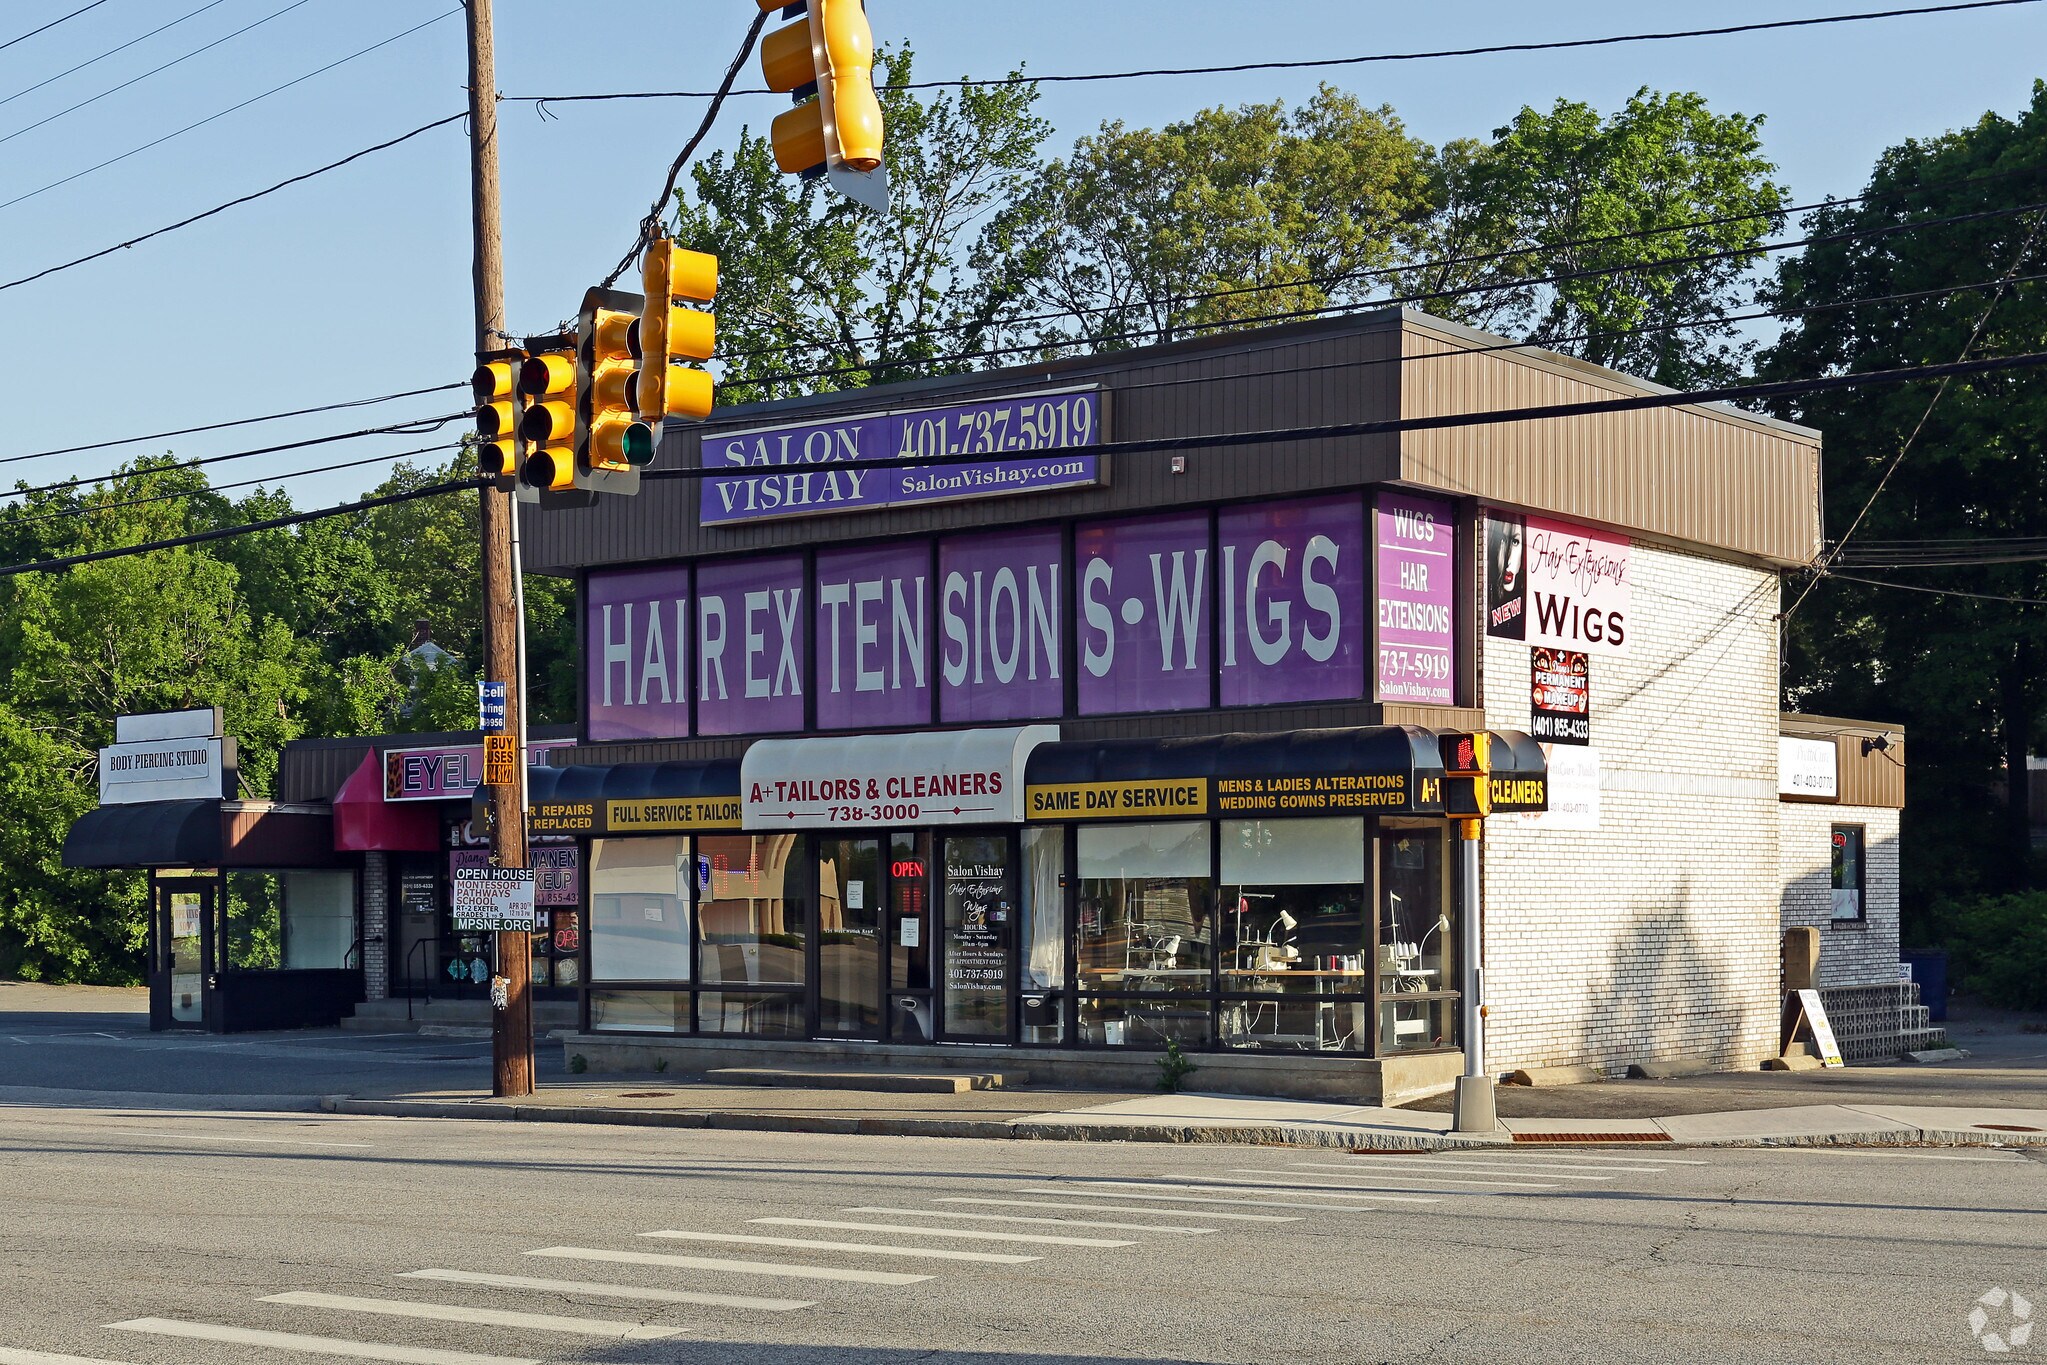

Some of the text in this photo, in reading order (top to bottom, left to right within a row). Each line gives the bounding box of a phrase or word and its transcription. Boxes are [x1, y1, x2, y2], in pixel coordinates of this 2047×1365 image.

[897, 397, 1092, 468] 401-737-5919
[724, 426, 864, 471] SALON
[901, 460, 1084, 494] SalonVishay.com
[715, 469, 870, 514] VISHAY
[1393, 507, 1435, 542] WIGS
[1531, 532, 1626, 597] Hair Extensions
[1400, 561, 1429, 592] HAIR
[602, 534, 1341, 707] HAIR EXTENSIONS WIGS
[1379, 599, 1449, 634] EXTENSIONS
[1491, 596, 1522, 627] NEW
[1533, 591, 1625, 646] WIGS
[1379, 650, 1450, 680] 737-5919
[1379, 679, 1450, 699] SalonVishay.com
[1535, 671, 1587, 689] PERMANENT
[1543, 690, 1579, 707] MAKEUP
[1533, 715, 1588, 739] (401) 855-4333
[492, 737, 513, 749] BUY
[110, 748, 208, 771] BODY PIERCING STUDIO
[403, 753, 484, 791] EYEL
[865, 778, 881, 800] &
[886, 772, 1003, 799] CLEANERS
[1218, 775, 1405, 793] MENS & LADIES ALTERATIONS
[1492, 779, 1544, 804] CLEANERS
[1033, 787, 1198, 811] SAME DAY SERVICE
[1219, 791, 1406, 810] WEDDING GOWNS PRESERVED
[542, 804, 593, 817] REPAIRS
[613, 806, 641, 823] FULL
[643, 804, 692, 822] SERVICE
[827, 803, 920, 821] 738-3000
[534, 817, 593, 830] REPLACED
[529, 849, 577, 868] MANEN
[456, 868, 534, 880] OPEN HOUSE
[892, 861, 923, 877] OPEN
[947, 865, 1004, 879] Salon Vishay
[457, 881, 521, 890] MONTESSORI
[457, 889, 511, 897] PATHWAYS
[456, 897, 495, 905] SCHOOL
[509, 902, 519, 910] APR
[963, 900, 988, 921] Wigs
[458, 919, 531, 931] MPSNE.ORG
[976, 933, 998, 941] Saturday
[948, 968, 1003, 979] 401-737-5919
[949, 982, 1002, 991] SalonVishay.com
